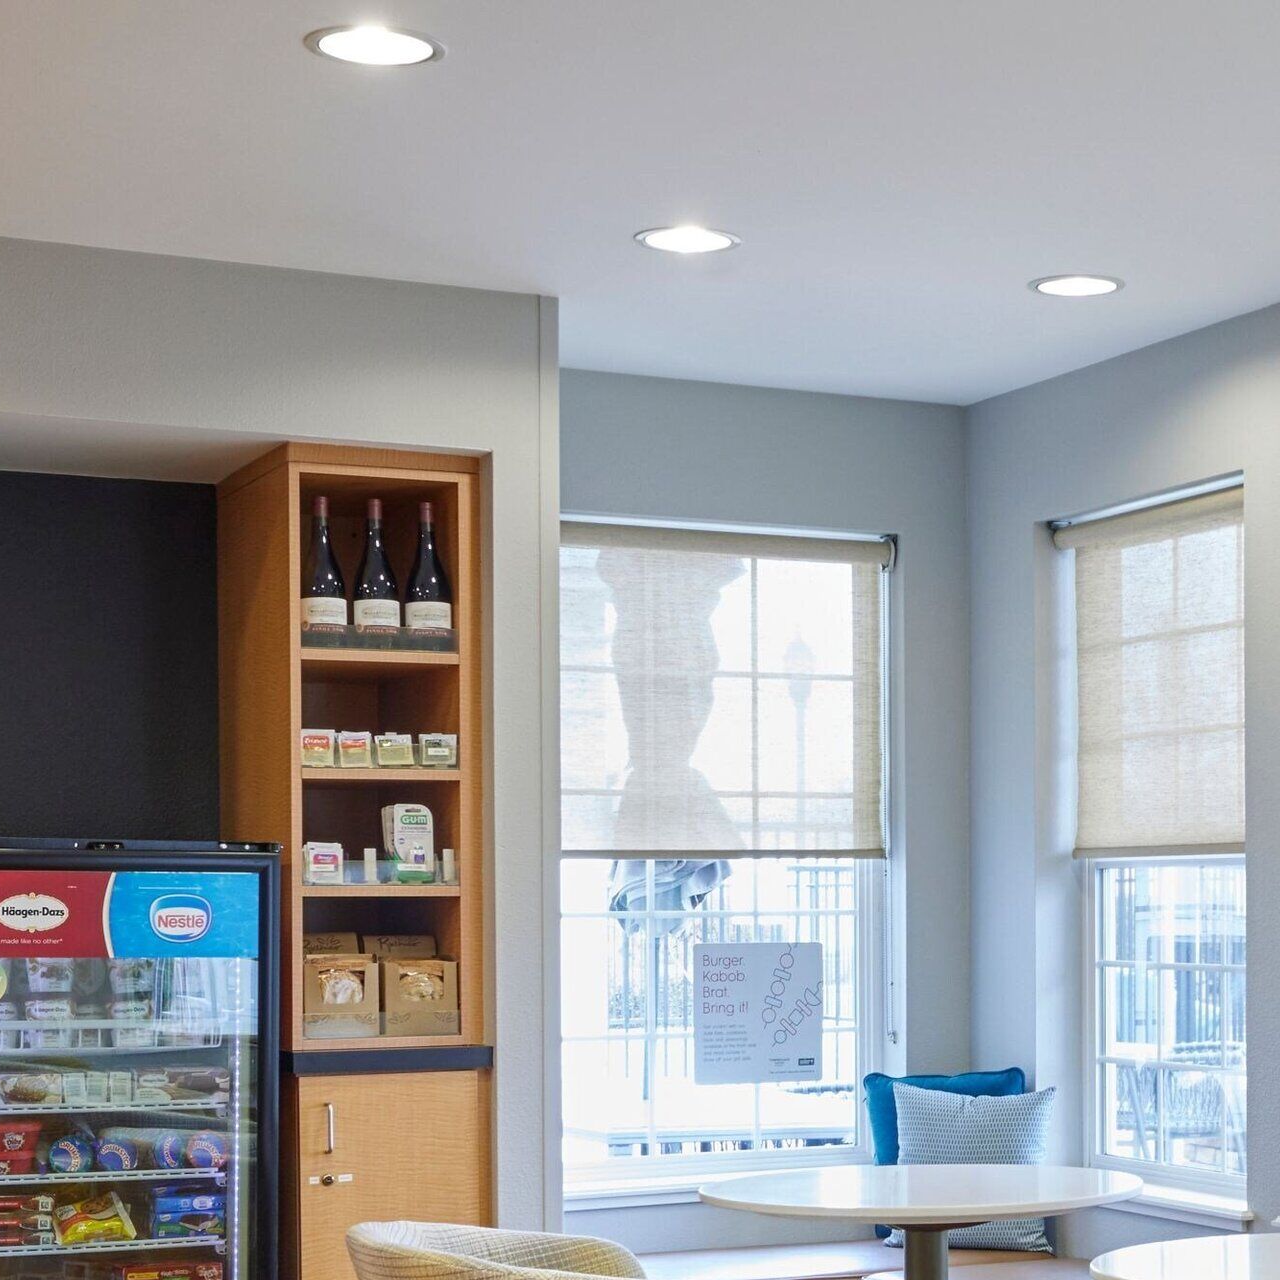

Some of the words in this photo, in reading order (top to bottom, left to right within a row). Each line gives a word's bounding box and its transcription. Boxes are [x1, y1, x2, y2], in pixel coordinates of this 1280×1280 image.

[1, 906, 65, 918] Häagen-Dazs
[702, 955, 745, 969] Burger.
[702, 970, 747, 982] Kabob.
[702, 1002, 735, 1016] Bring
[739, 1001, 749, 1013] it!
